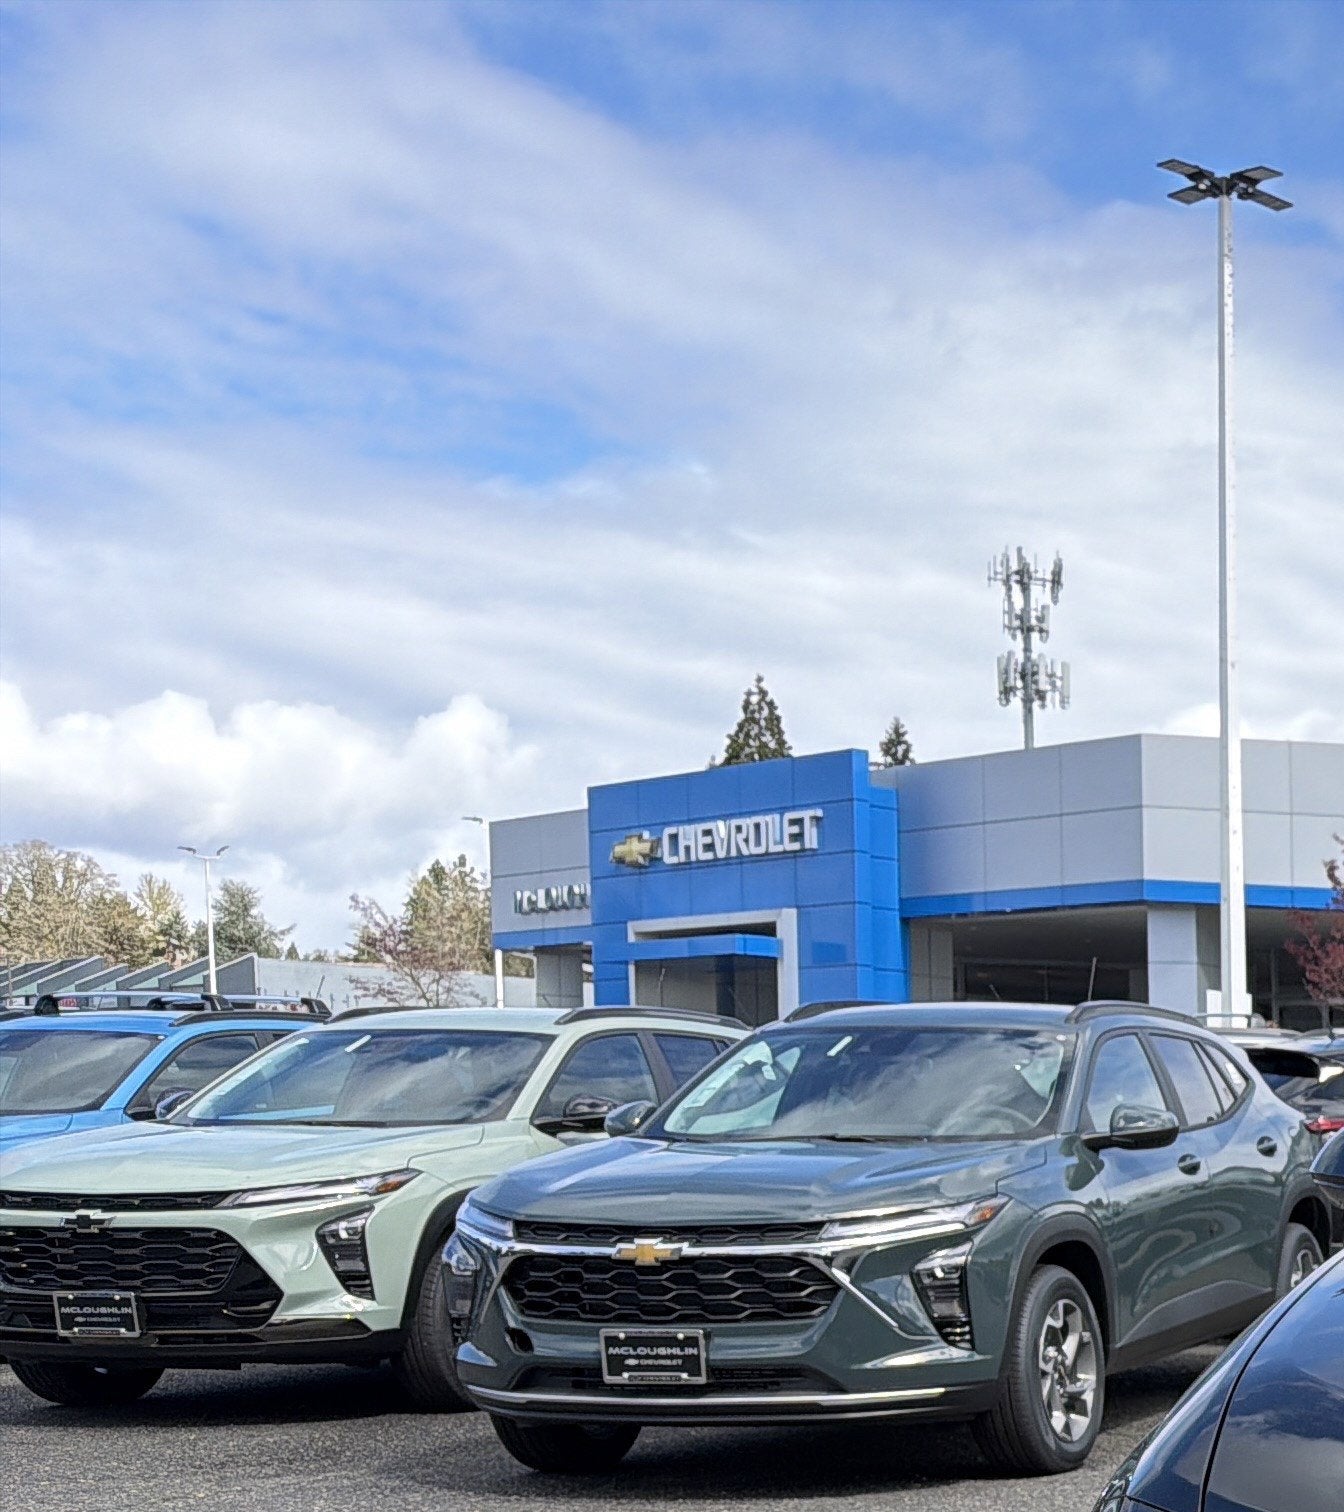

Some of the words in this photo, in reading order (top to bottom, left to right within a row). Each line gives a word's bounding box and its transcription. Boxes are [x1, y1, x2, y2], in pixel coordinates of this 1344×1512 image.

[662, 808, 824, 865] CHEVROLET
[60, 1306, 133, 1314] MCLOUGHLIN
[607, 1346, 699, 1356] MCLOUGHLIN
